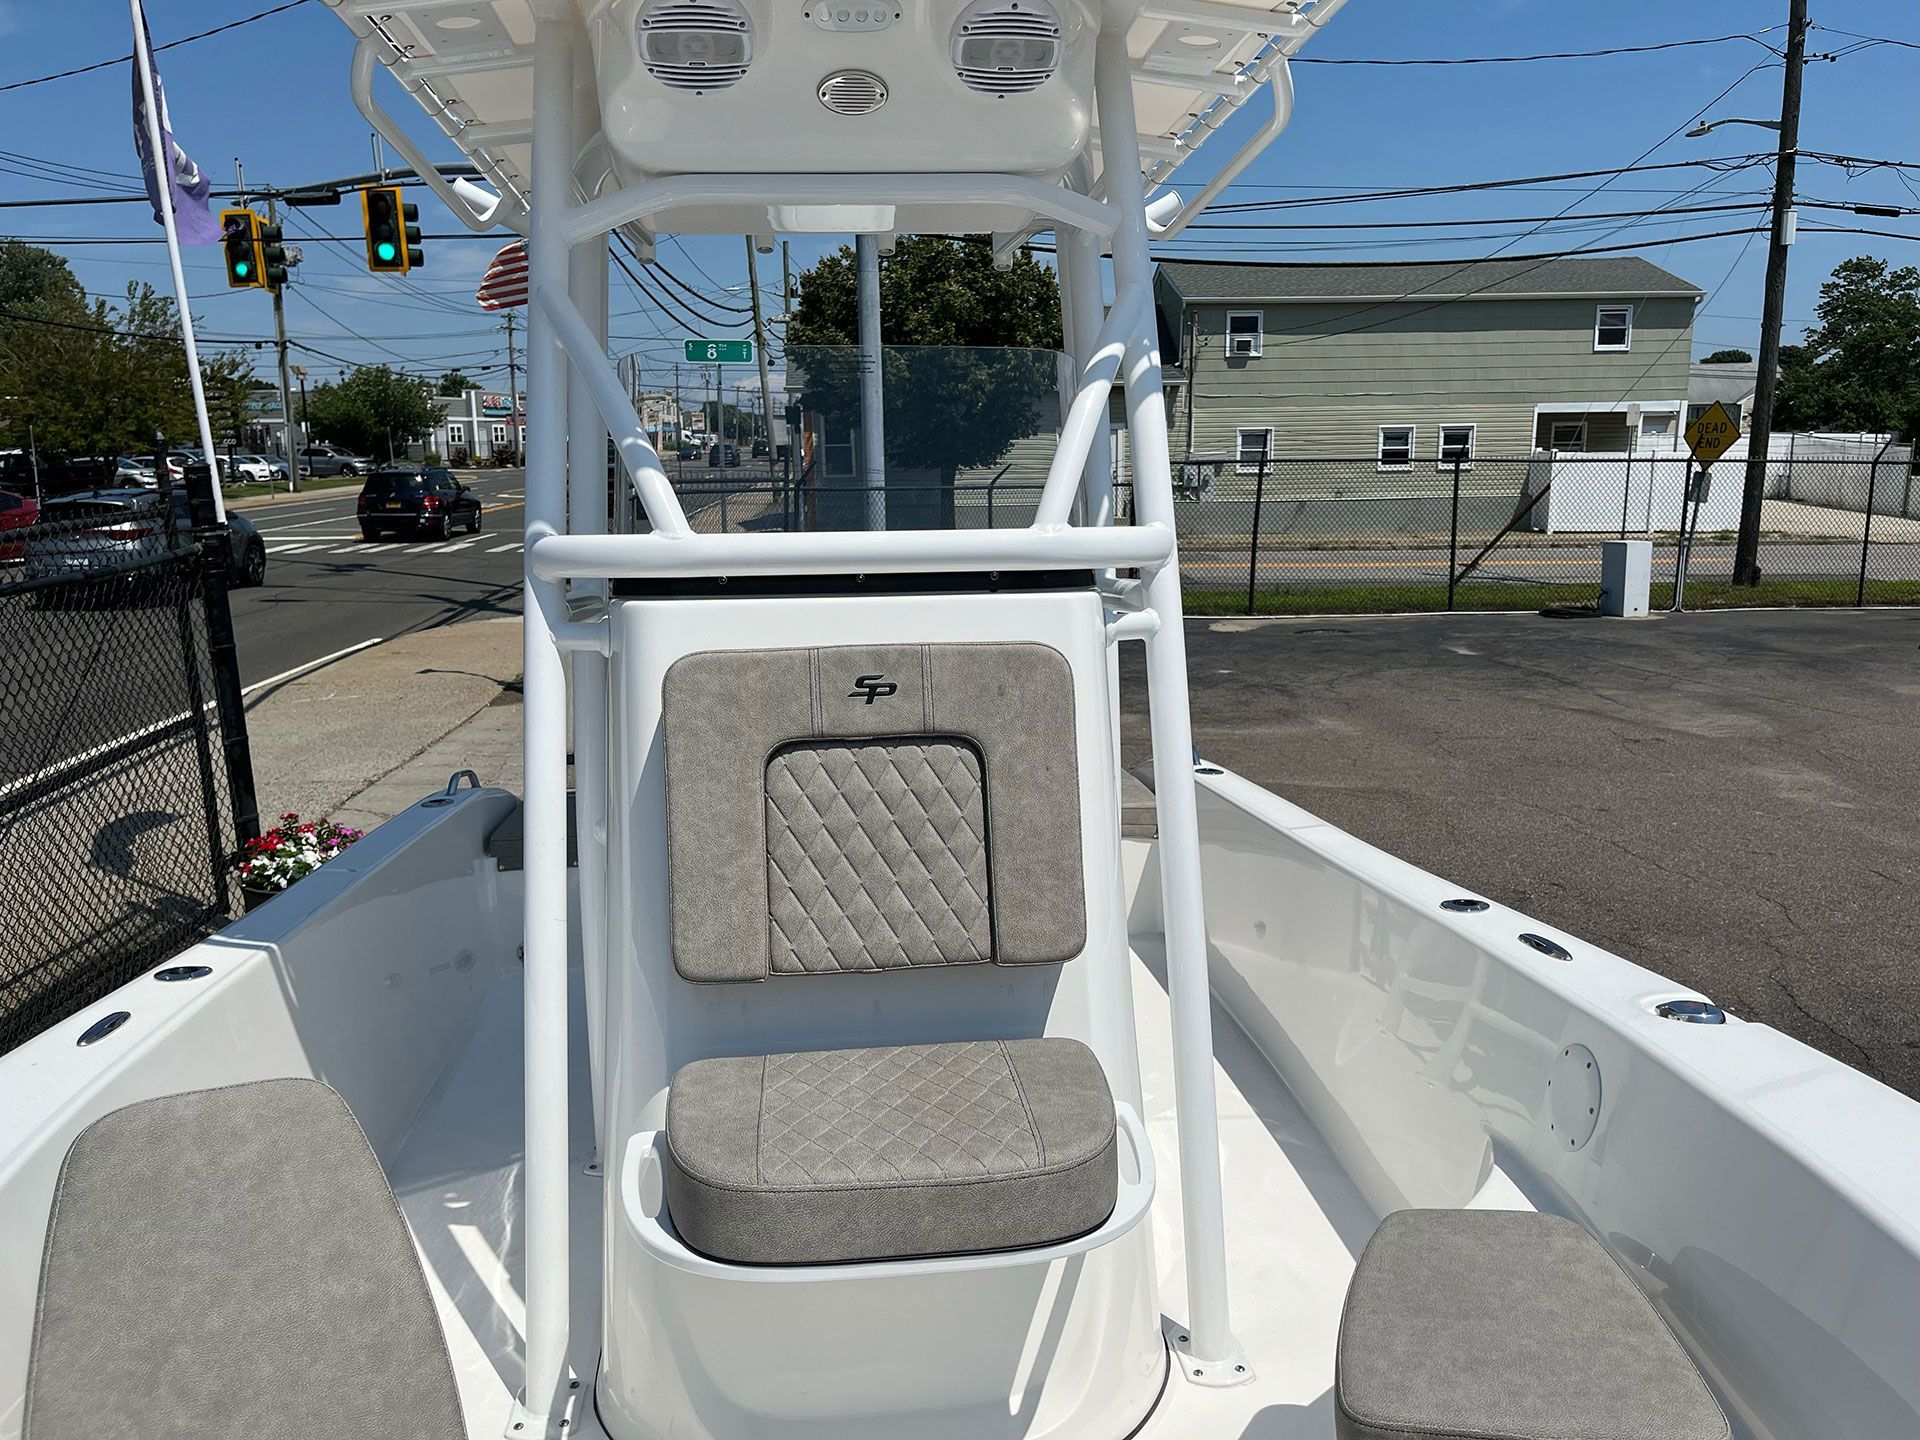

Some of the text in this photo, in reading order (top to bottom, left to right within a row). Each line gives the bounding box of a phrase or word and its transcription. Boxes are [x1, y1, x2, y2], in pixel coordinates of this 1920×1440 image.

[1697, 422, 1728, 434] DEAD
[1698, 437, 1721, 449] END
[847, 674, 898, 705] SP
